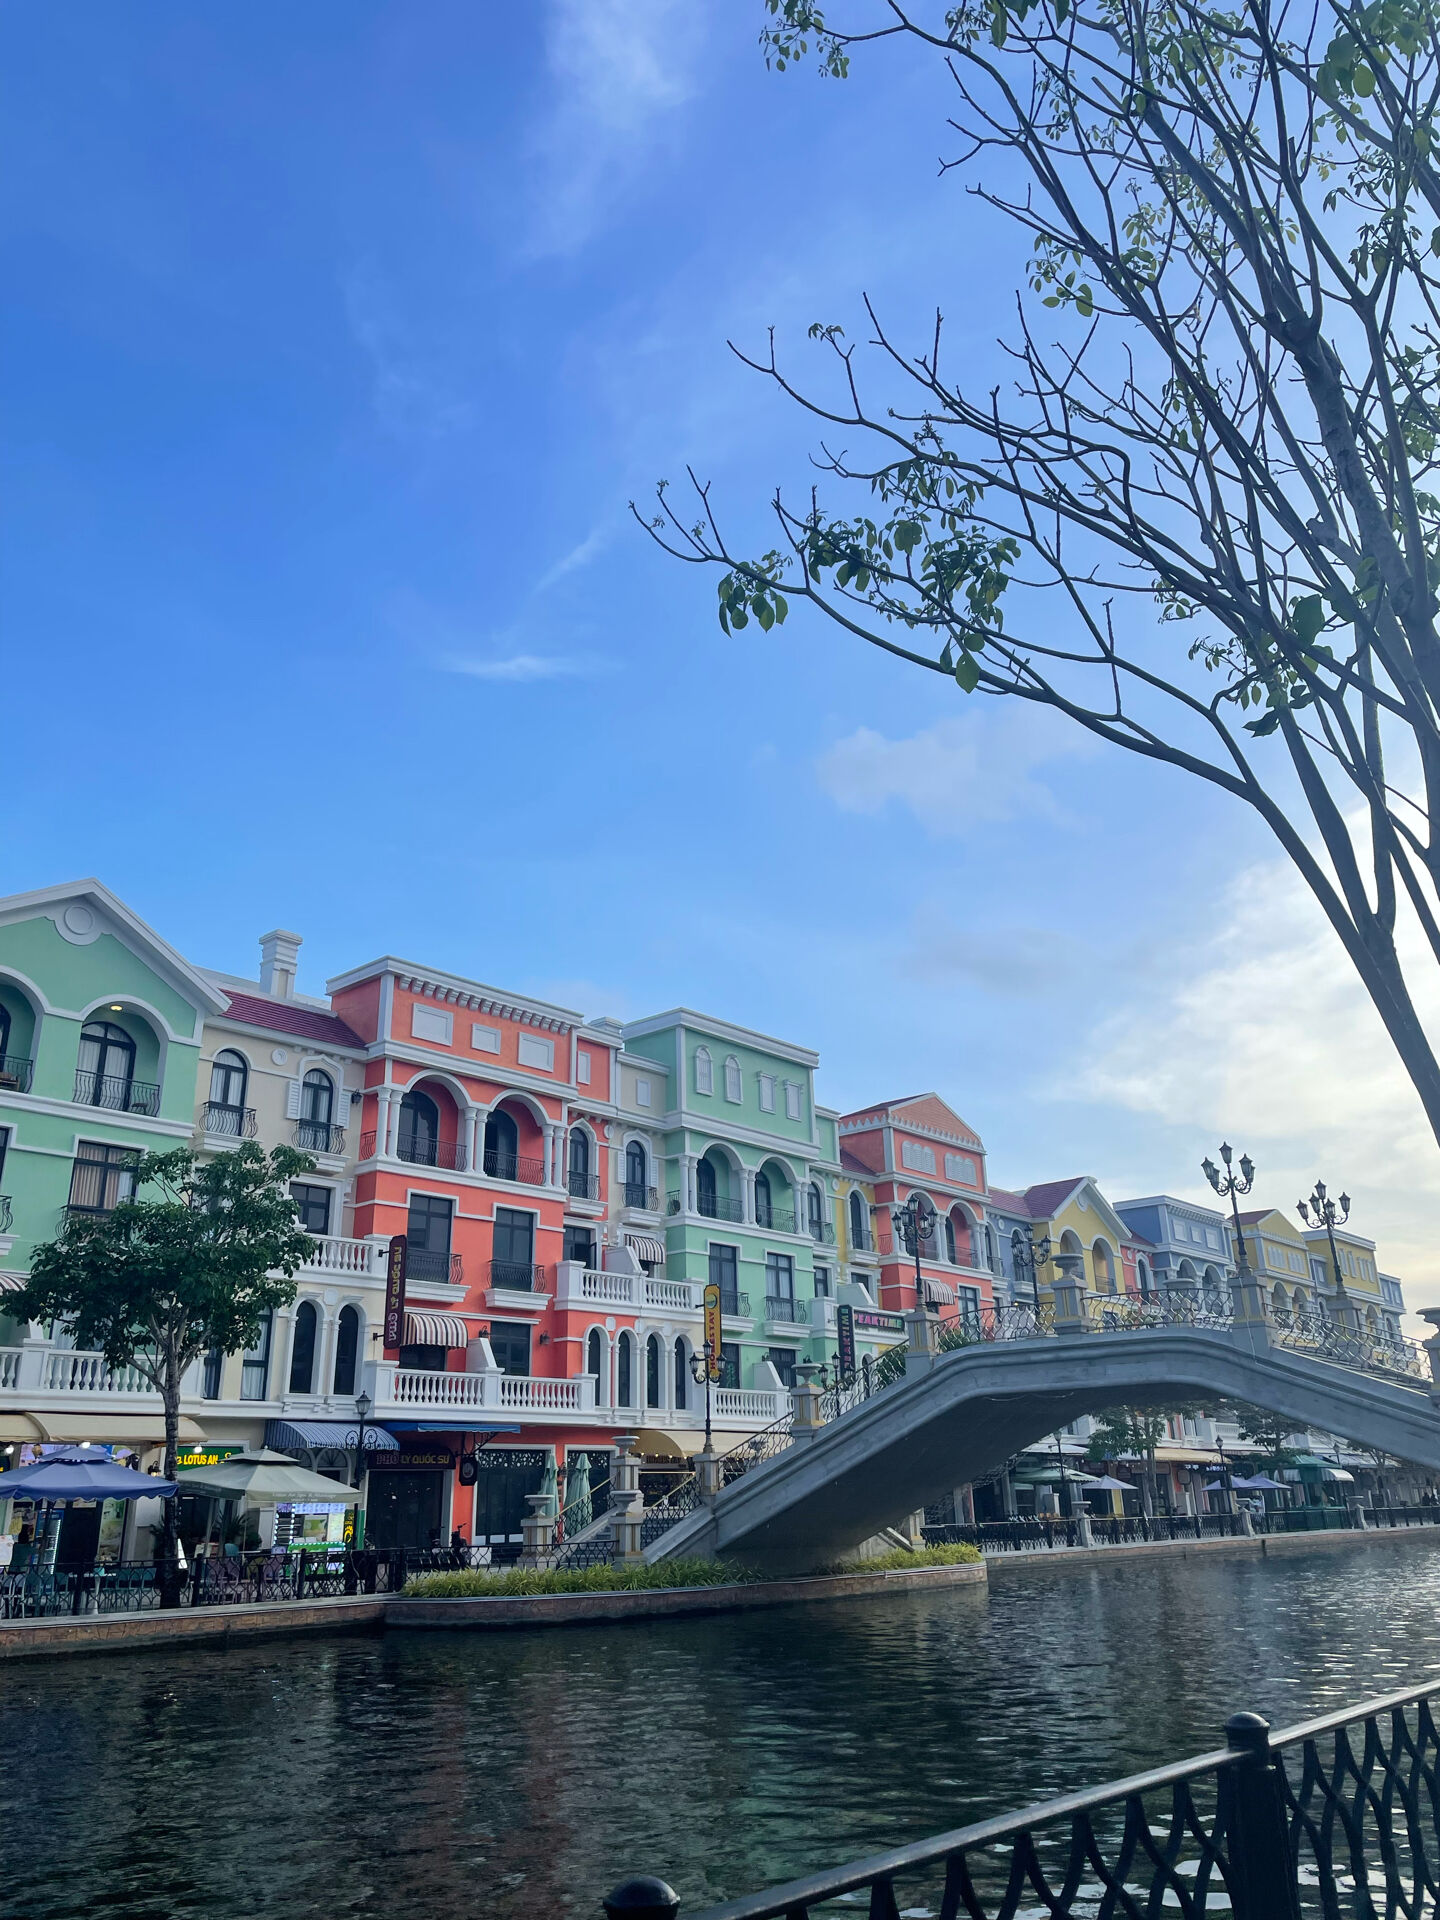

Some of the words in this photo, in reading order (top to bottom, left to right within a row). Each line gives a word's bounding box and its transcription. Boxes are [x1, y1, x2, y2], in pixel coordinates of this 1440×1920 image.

[853, 1313, 902, 1328] PEAKTIME
[183, 1454, 207, 1465] LOTUS
[207, 1454, 219, 1465] AN
